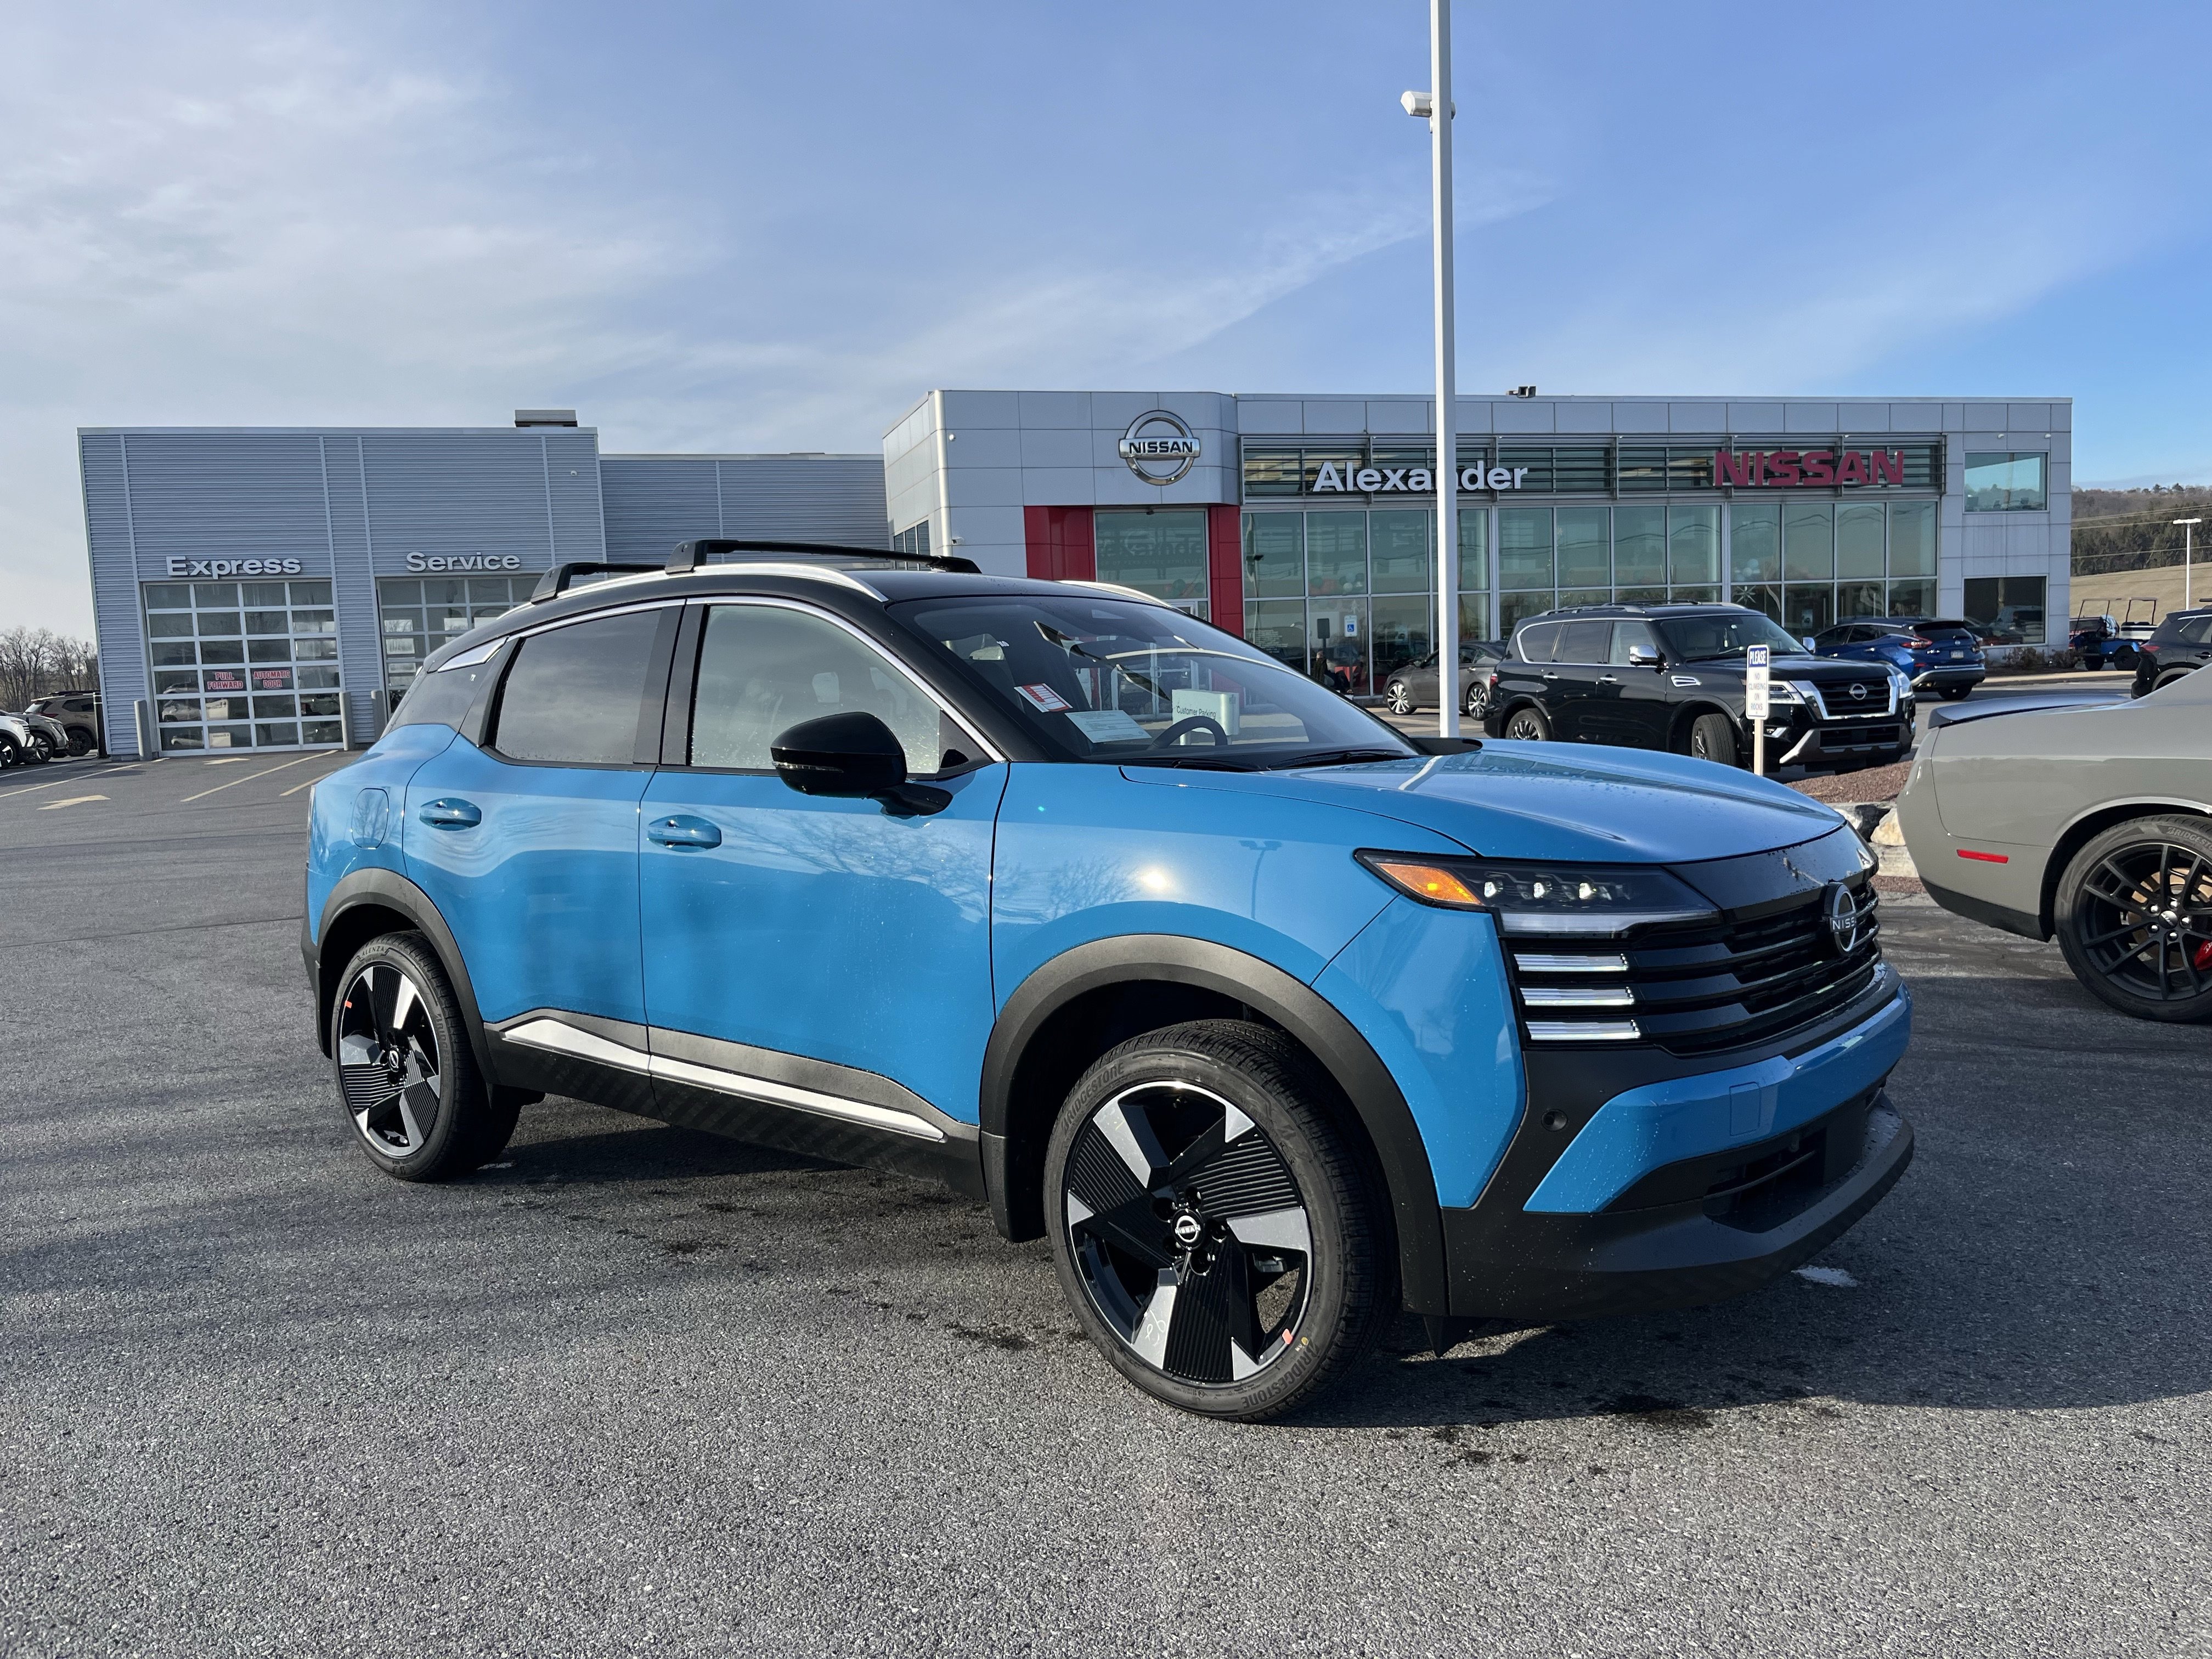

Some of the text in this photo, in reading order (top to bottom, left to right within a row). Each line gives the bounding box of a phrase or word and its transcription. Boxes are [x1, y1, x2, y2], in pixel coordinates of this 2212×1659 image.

[1128, 441, 1193, 454] NISSAN
[1312, 460, 1528, 492] Alexader
[1713, 450, 1904, 487] NISSAN
[166, 555, 301, 580] Express
[406, 551, 521, 572] Service
[1750, 650, 1767, 665] PLEASE
[215, 672, 235, 680] PULL
[253, 670, 291, 679] AUTOMATIC
[207, 680, 244, 690] FORWARD
[262, 679, 283, 689] DOOR
[1176, 705, 1216, 720] Customer Parking
[1832, 917, 1855, 930] NISS
[362, 946, 384, 956] ALENZA
[1061, 1062, 1125, 1134] BRIDGESTONE
[1240, 1339, 1320, 1409] BRIDGESTONE
